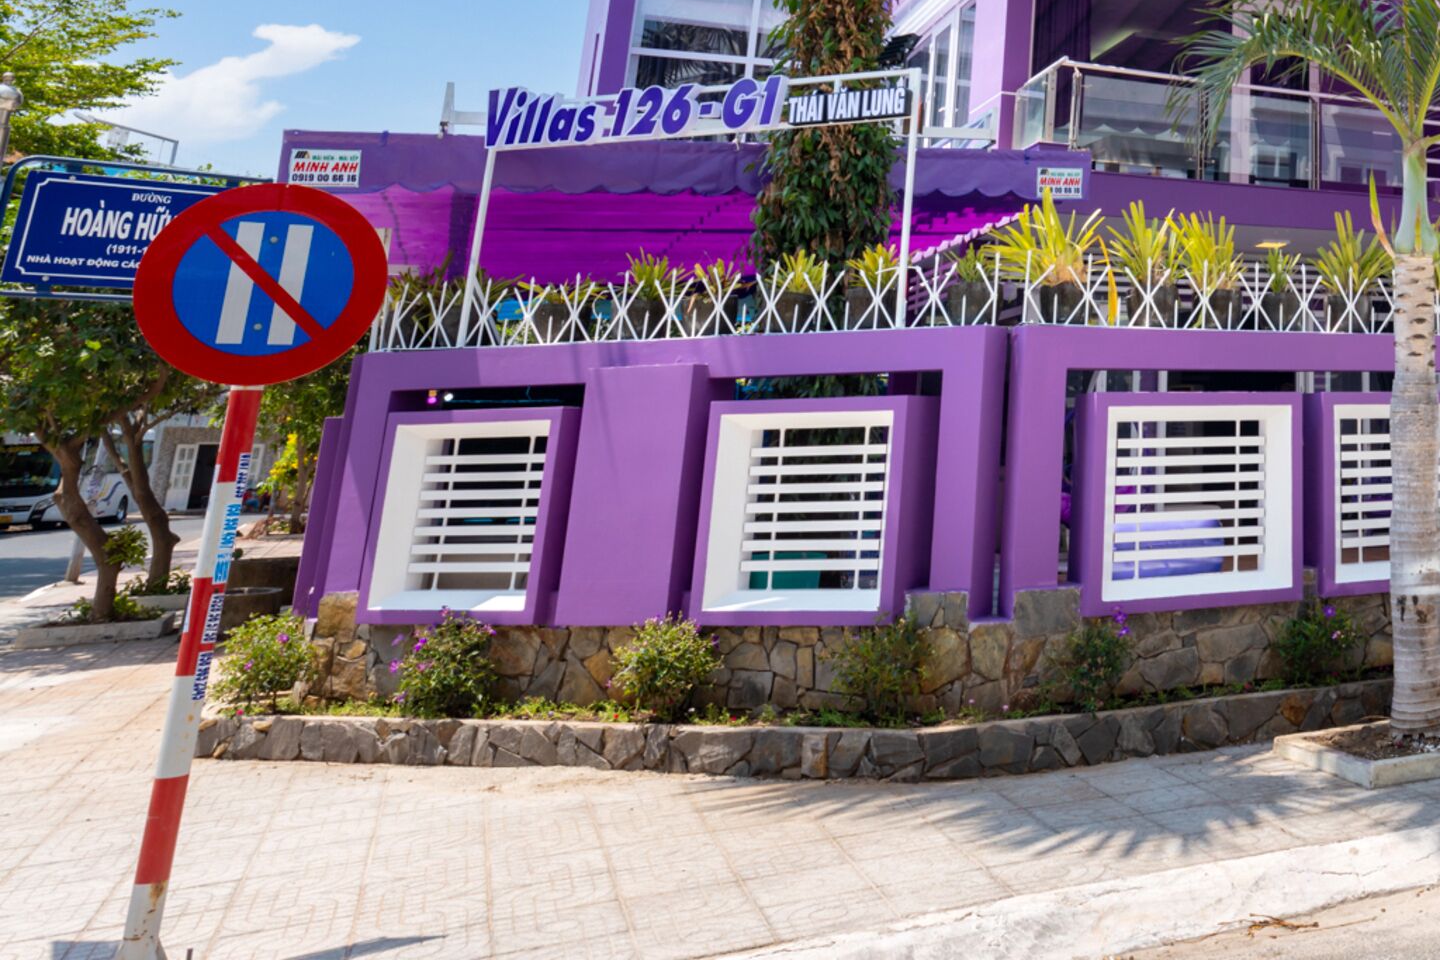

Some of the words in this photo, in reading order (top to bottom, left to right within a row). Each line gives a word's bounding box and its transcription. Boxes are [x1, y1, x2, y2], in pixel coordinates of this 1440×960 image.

[486, 87, 597, 147] Villas
[789, 90, 825, 123] THÁI
[827, 87, 860, 120] VĂN
[861, 87, 906, 117] LUNG
[294, 161, 328, 173] MINH
[332, 162, 359, 173] ANH
[132, 192, 172, 204] ĐƯỜNG
[61, 200, 133, 240] HOÀNG
[134, 205, 177, 241] HỮ
[27, 253, 51, 264] NHÀ
[54, 256, 86, 266] HOẠT
[86, 257, 119, 268] ĐỘNG
